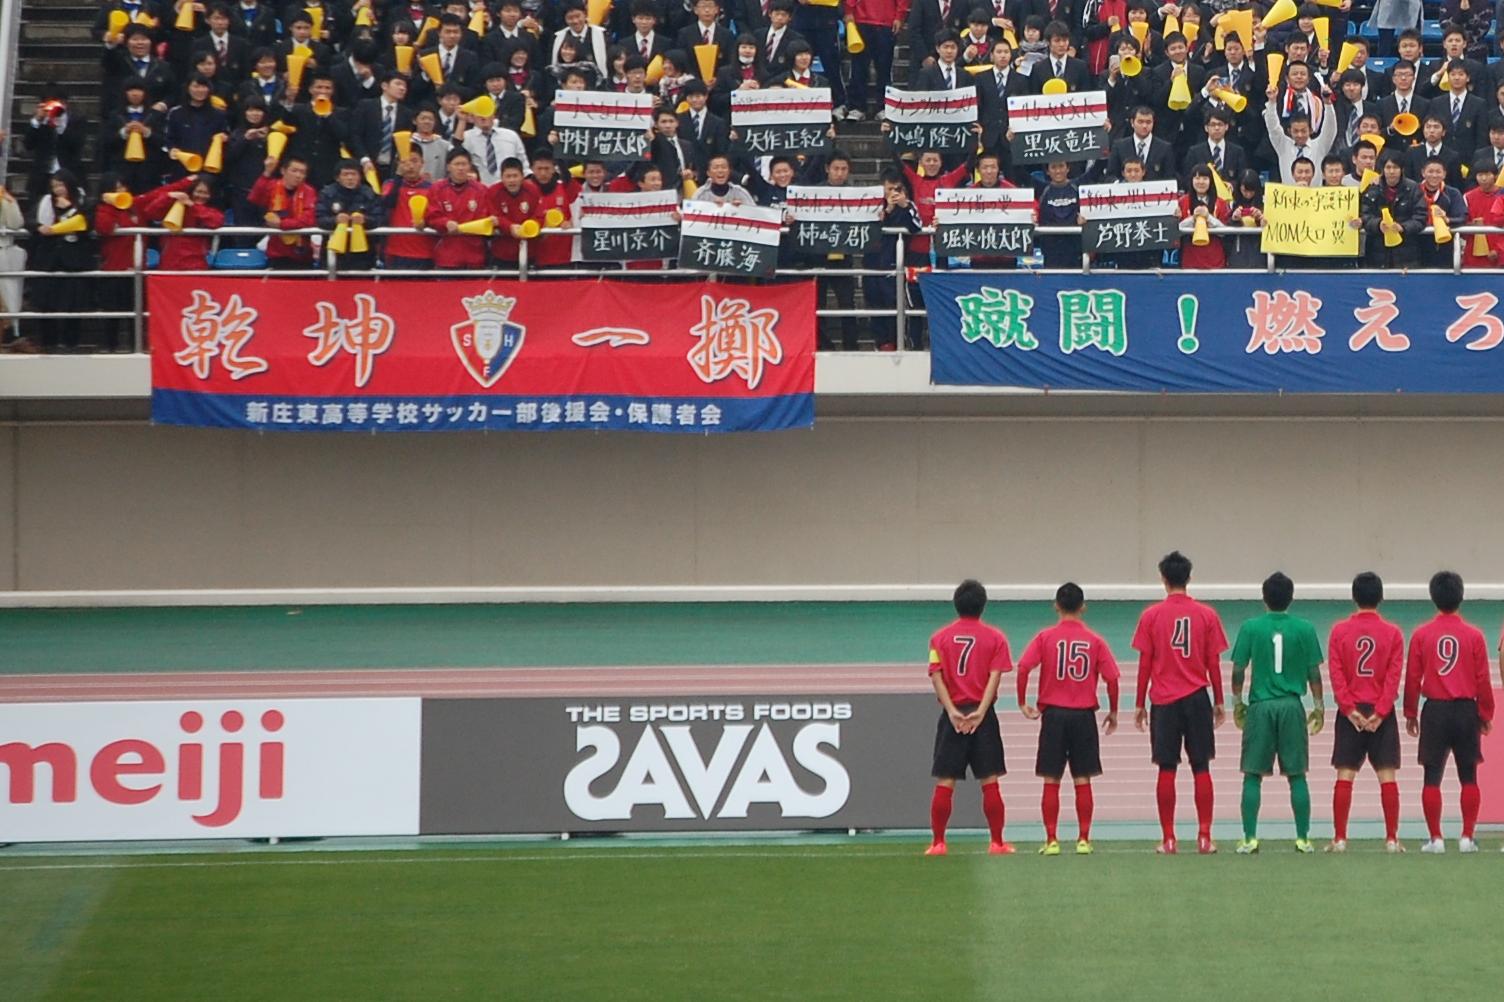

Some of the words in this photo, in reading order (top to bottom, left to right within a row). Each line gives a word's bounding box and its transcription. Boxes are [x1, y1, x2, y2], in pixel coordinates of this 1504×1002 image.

[745, 128, 824, 152] 矢作正紀
[1024, 130, 1101, 157] 黒坂竜生
[593, 229, 672, 252] 星川京介
[952, 636, 976, 676] 7
[1170, 617, 1192, 658] 4
[1272, 633, 1284, 674] 1
[1356, 636, 1376, 677] 2
[1436, 636, 1459, 675] 9
[1056, 640, 1089, 681] 15
[566, 706, 620, 722] THE
[630, 704, 744, 721] SPORTS
[753, 703, 852, 720] FOODS
[0, 709, 285, 827] meiji
[563, 722, 851, 821] SAVAS
